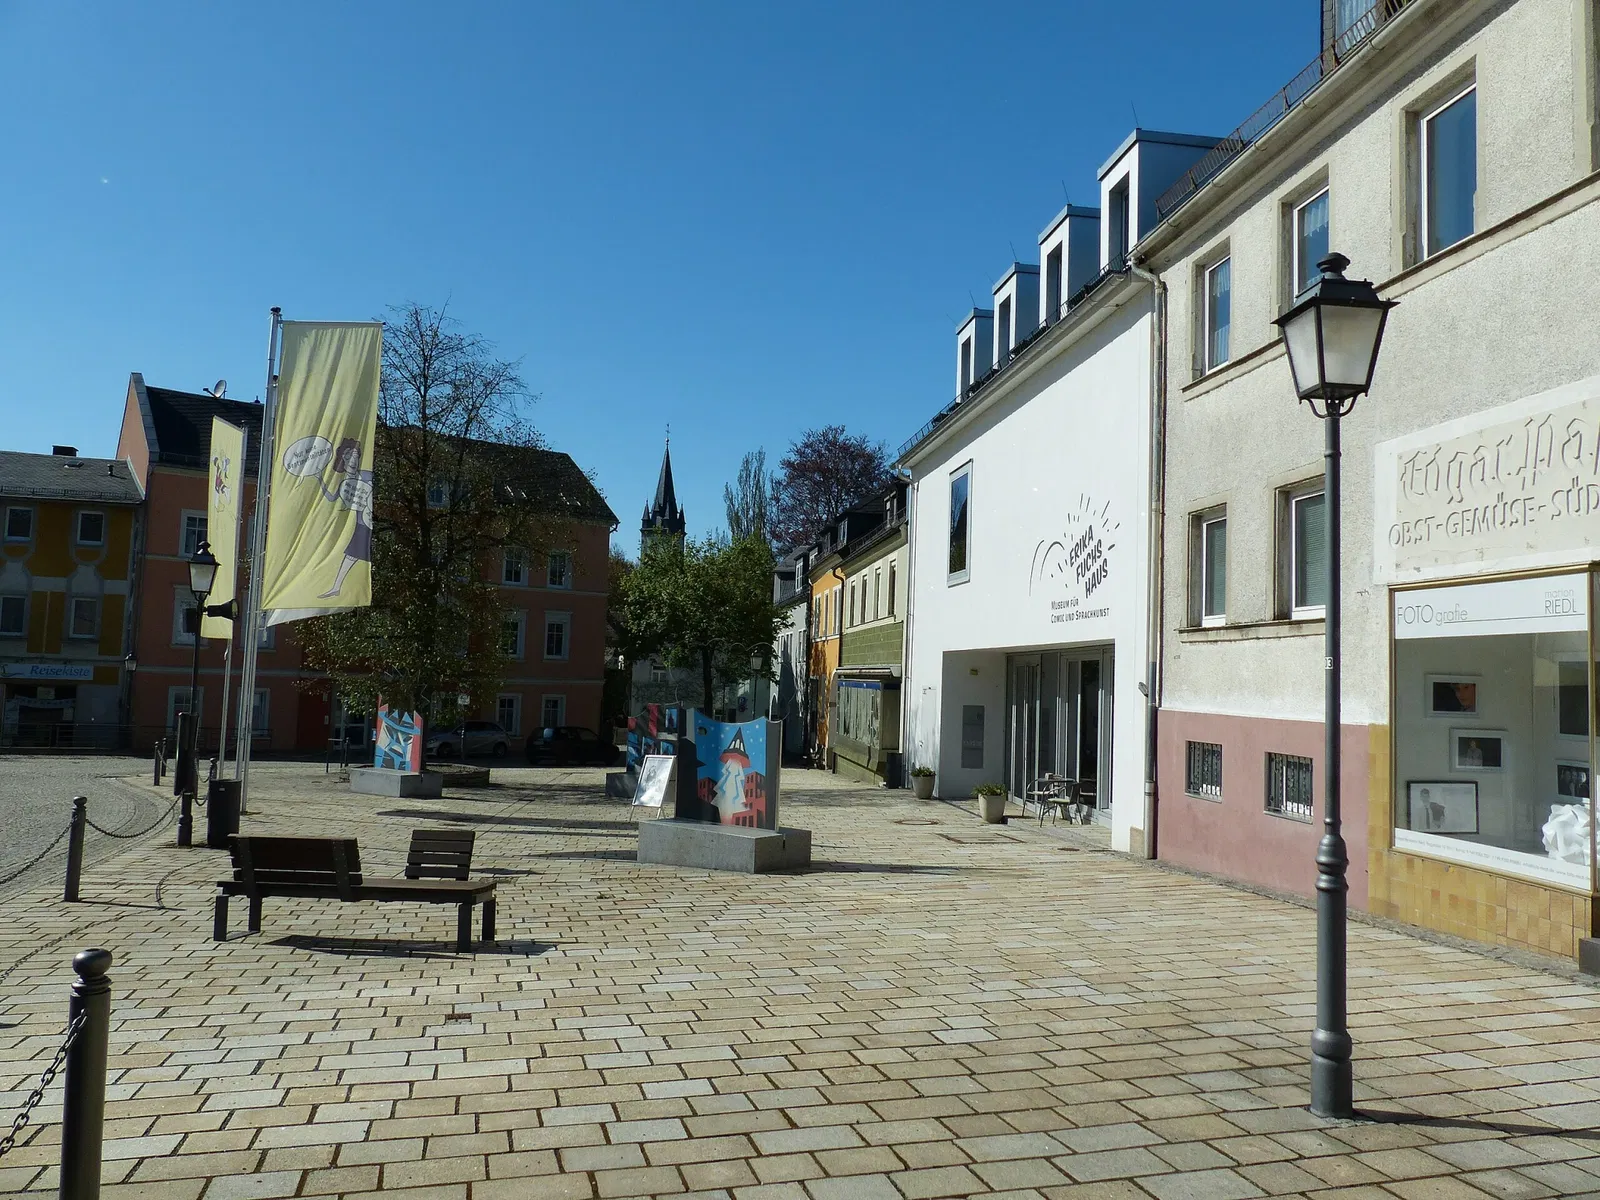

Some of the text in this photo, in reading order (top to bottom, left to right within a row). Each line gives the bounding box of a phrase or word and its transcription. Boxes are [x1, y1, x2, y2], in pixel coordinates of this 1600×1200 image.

[1070, 525, 1094, 567] ERIKA
[1076, 539, 1102, 584] FUCHS
[1084, 558, 1108, 599] HAUS
[1545, 588, 1574, 599] marion
[1545, 598, 1577, 614] RIEDL
[30, 665, 90, 677] Reisekiste
